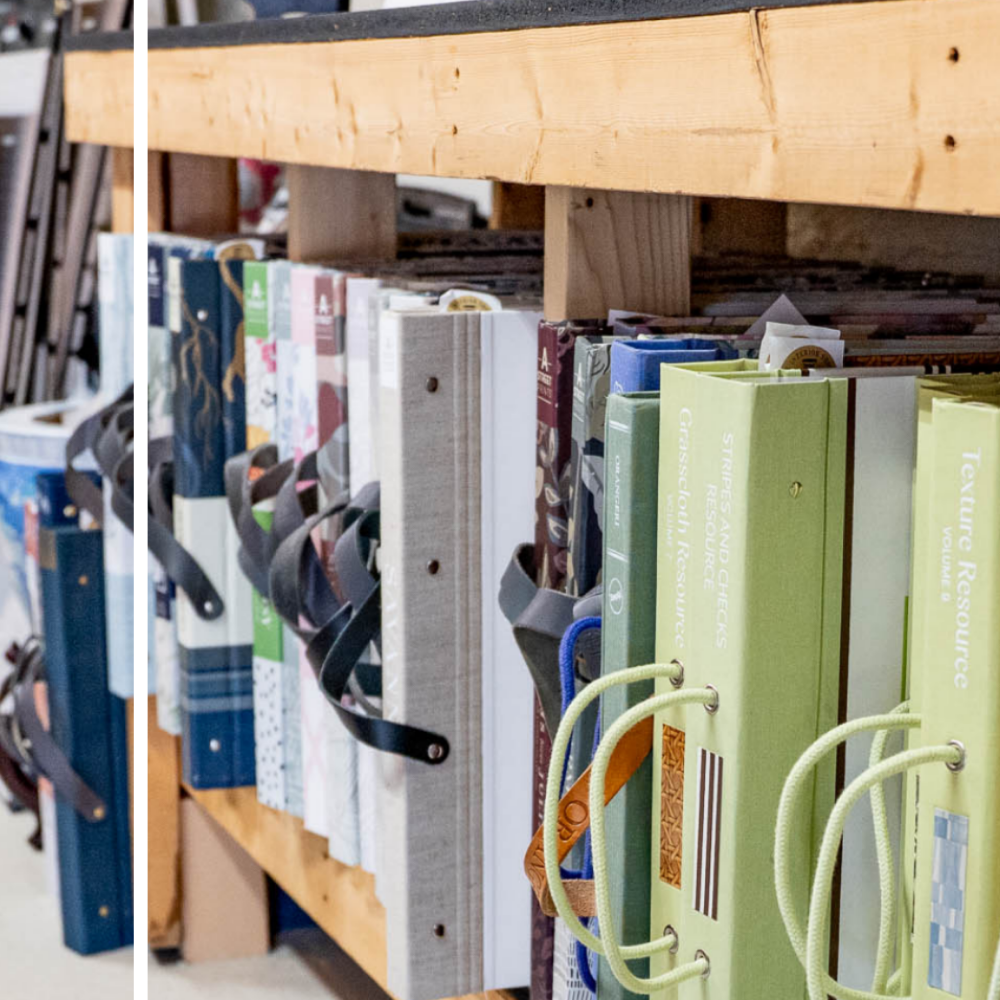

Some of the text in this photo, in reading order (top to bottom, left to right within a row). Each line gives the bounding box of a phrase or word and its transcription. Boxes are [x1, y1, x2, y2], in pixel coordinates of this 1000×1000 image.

[613, 454, 621, 527] ORANGERI
[675, 406, 694, 649] Grasscloth Resource
[702, 483, 718, 591] RESOURCE
[715, 432, 734, 650] STRIPES AND CHECKS
[941, 526, 953, 588] VOLUME
[953, 446, 982, 690] Texture Resource
